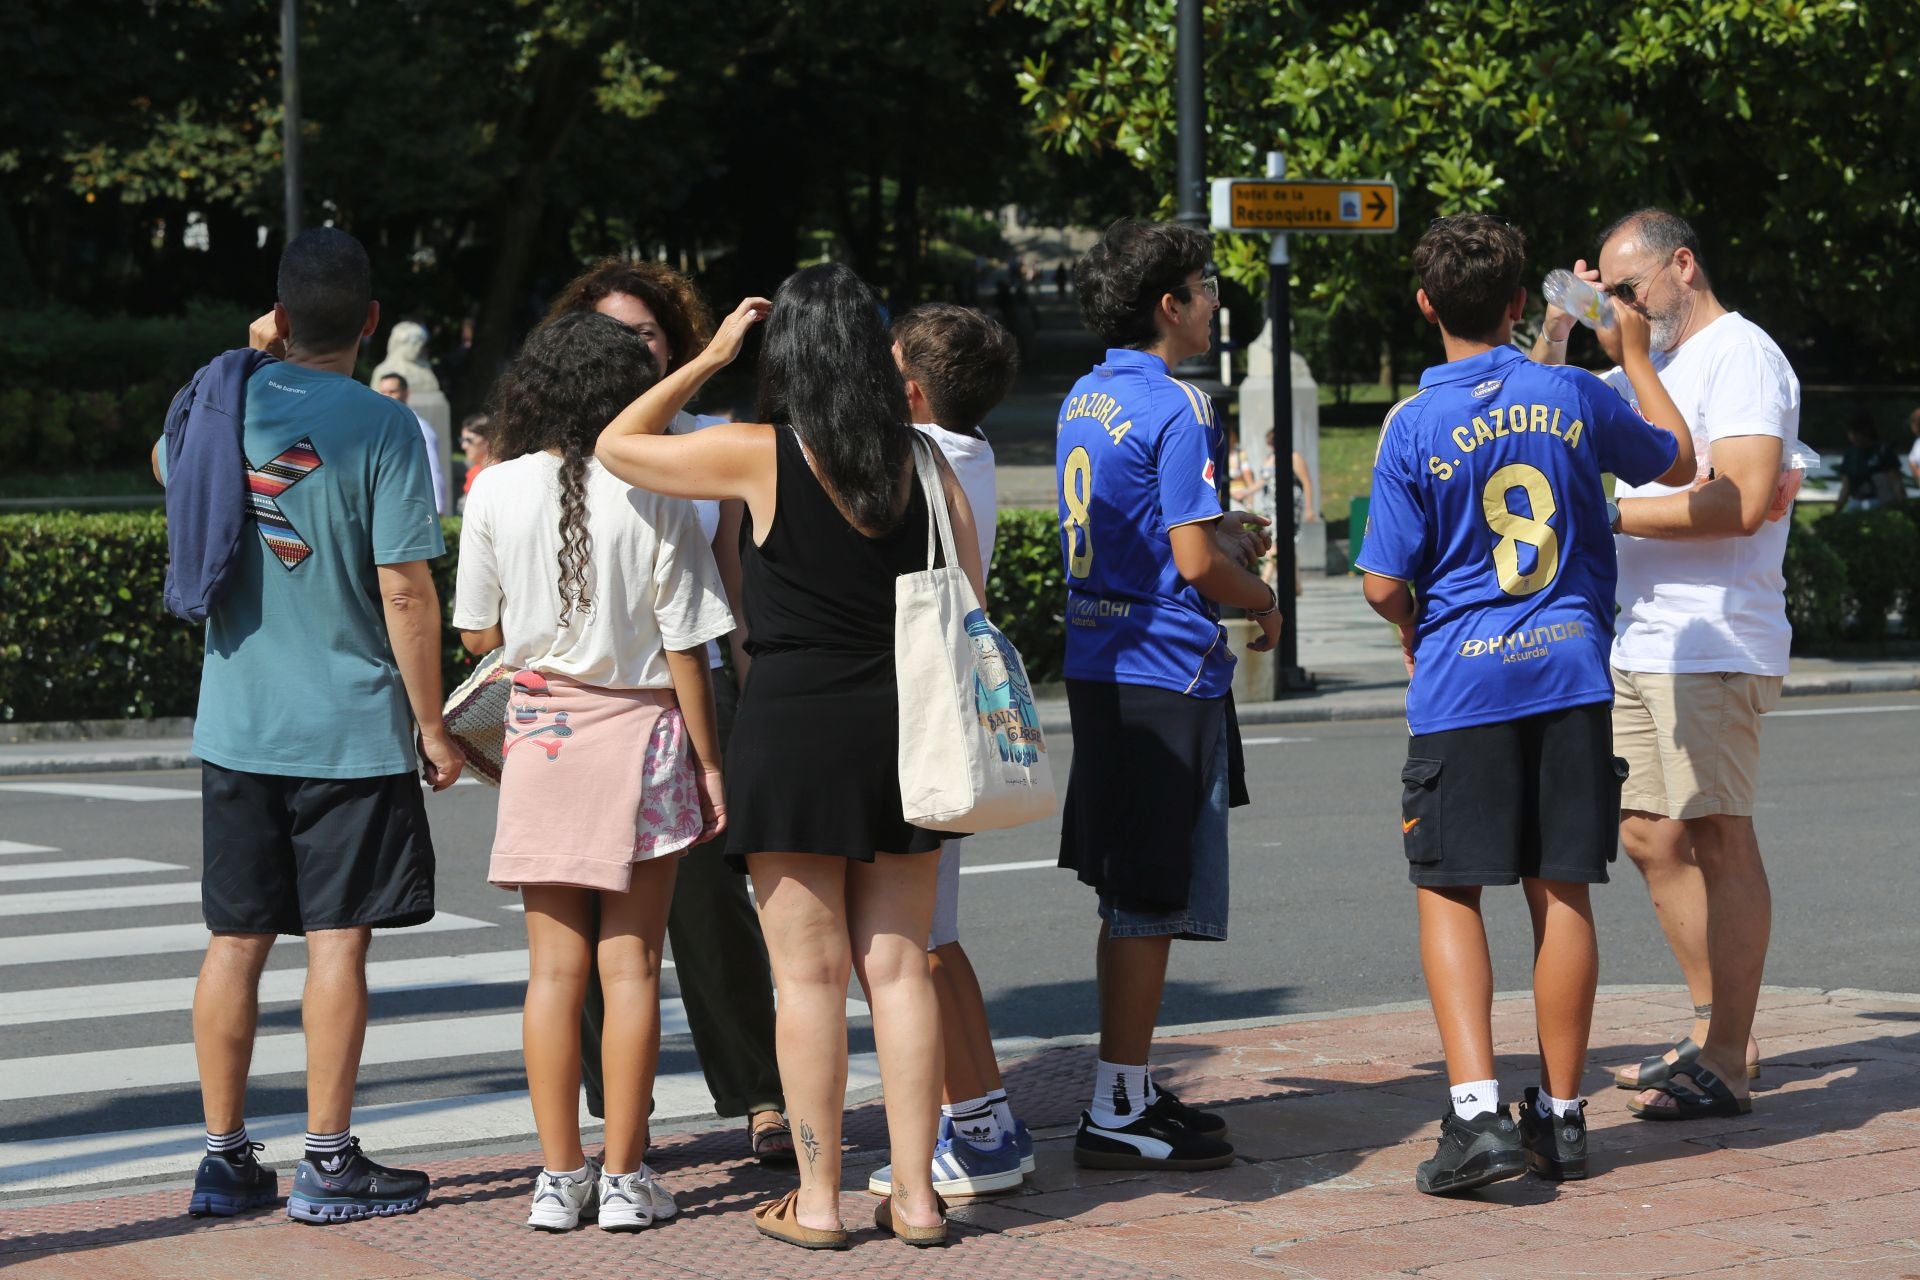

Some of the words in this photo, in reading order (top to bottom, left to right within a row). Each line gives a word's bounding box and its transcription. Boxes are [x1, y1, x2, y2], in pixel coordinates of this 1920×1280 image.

[1236, 189, 1267, 200] hotel
[1273, 189, 1287, 200] de
[1292, 189, 1304, 200] la
[1236, 206, 1332, 224] Reconquista
[268, 380, 282, 390] blue
[1066, 392, 1132, 446] CAZORLA
[1428, 455, 1462, 481] S.
[1451, 404, 1584, 453] CAZORLA
[1063, 445, 1094, 579] 8
[1482, 463, 1559, 596] 8
[1488, 621, 1586, 654] HYUNDAI
[1503, 645, 1549, 664] Asturdai
